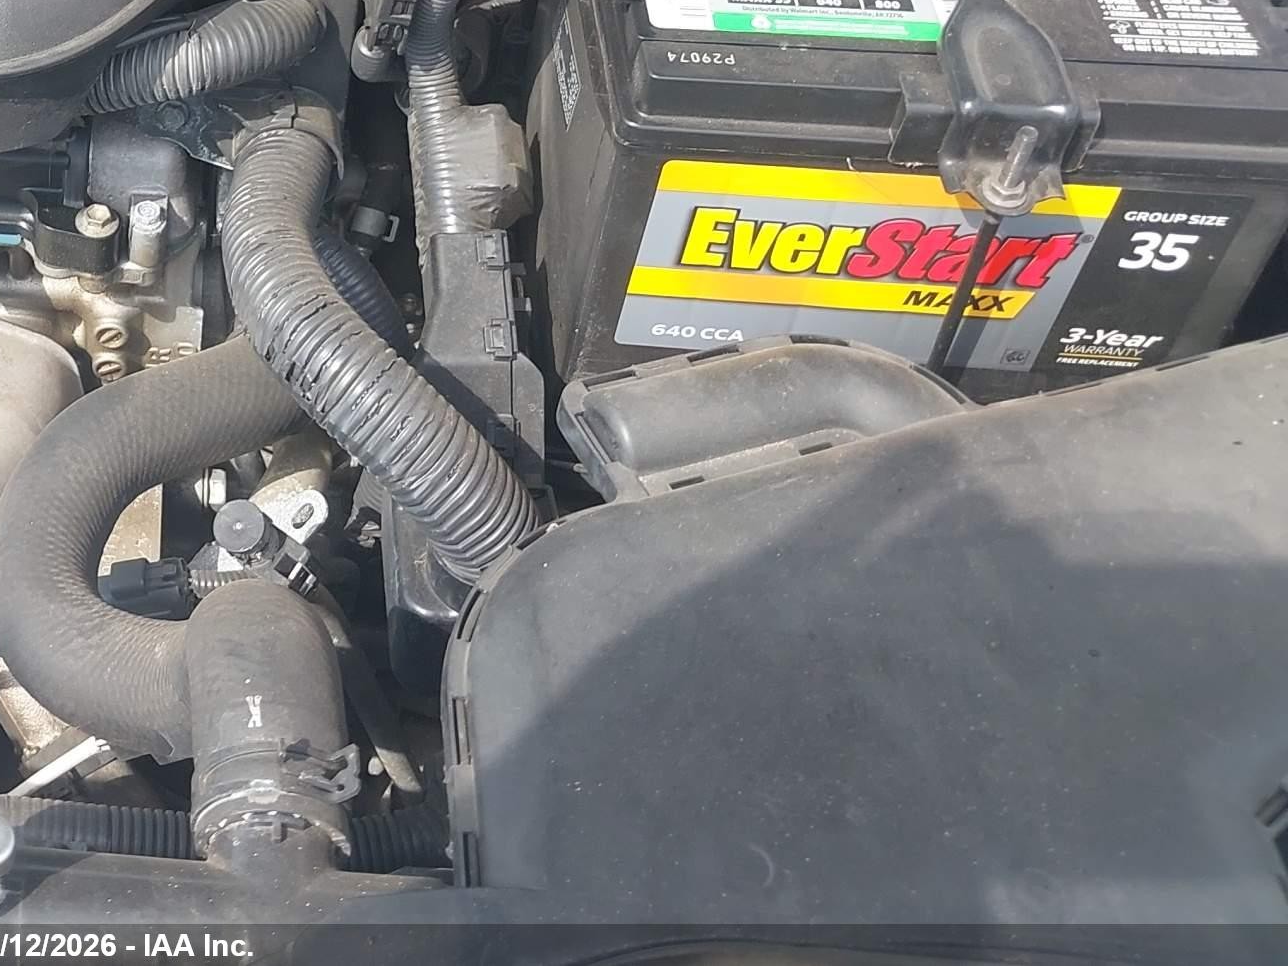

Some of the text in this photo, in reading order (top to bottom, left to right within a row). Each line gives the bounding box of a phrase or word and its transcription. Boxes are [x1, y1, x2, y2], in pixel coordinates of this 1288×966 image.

[666, 50, 736, 66] P29074
[1124, 210, 1230, 227] GROUP SIZE
[679, 206, 1088, 289] EverStart
[1118, 231, 1200, 272] 35
[651, 324, 744, 342] 640 CCA
[1060, 328, 1164, 348] 3-Year
[1064, 345, 1145, 357] WARRANTY
[1078, 358, 1140, 367] REPLACEMENT
